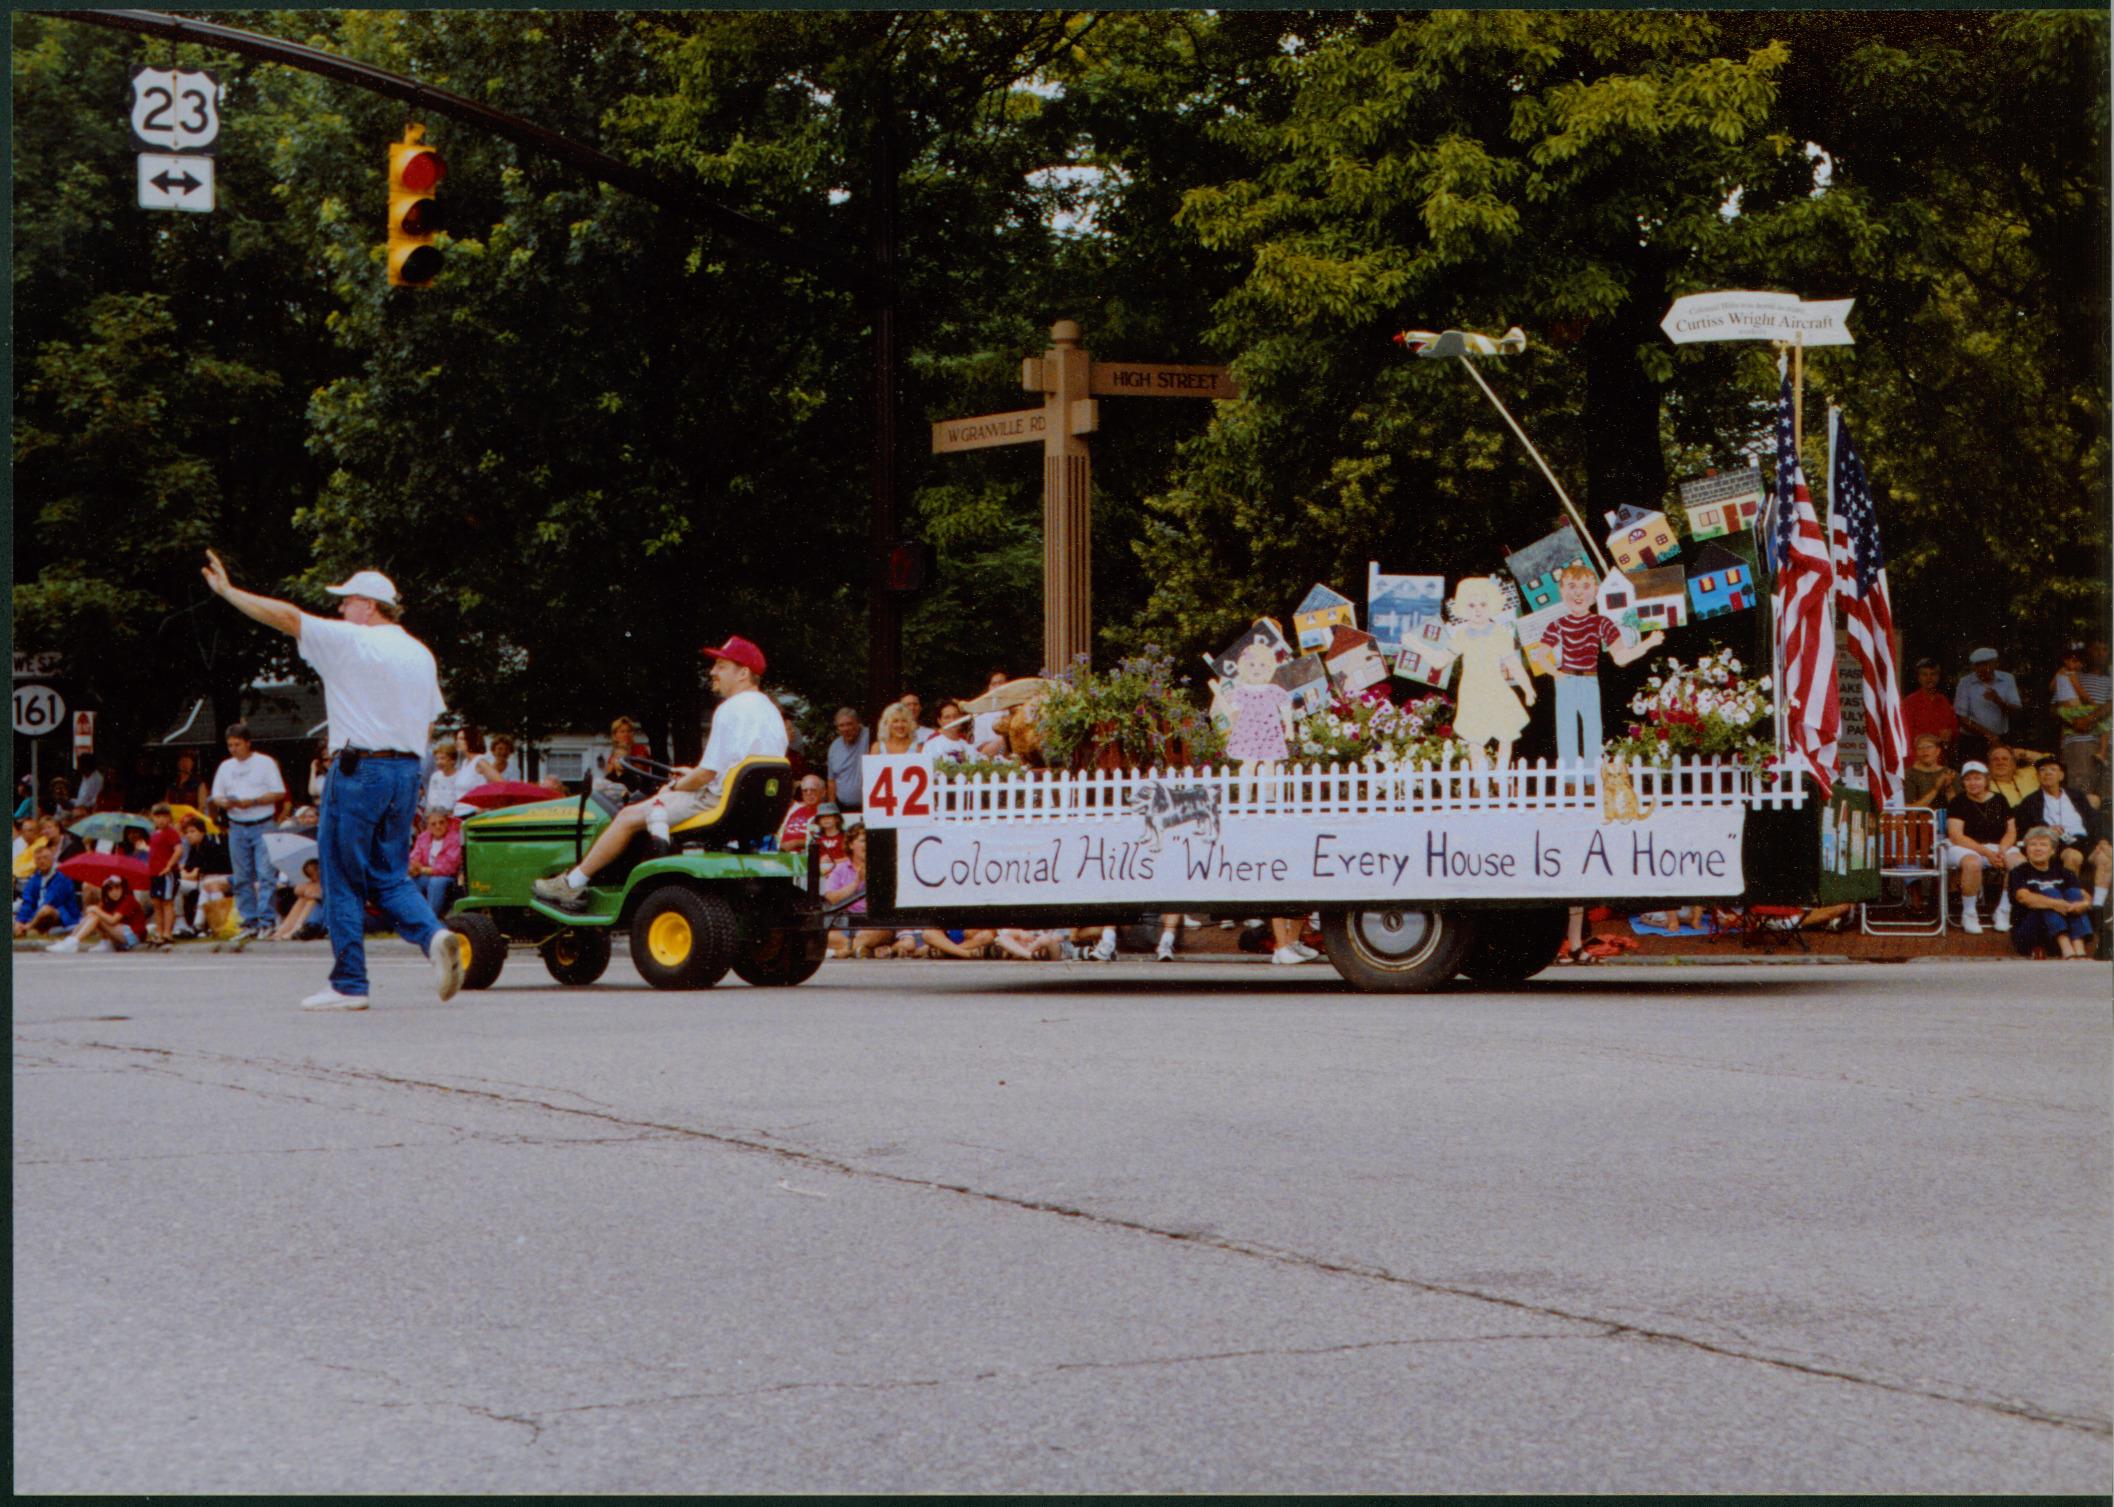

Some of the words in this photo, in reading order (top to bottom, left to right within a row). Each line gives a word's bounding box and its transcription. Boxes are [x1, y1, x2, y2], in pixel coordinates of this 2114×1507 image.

[143, 86, 209, 134] 23
[1675, 314, 1725, 333] Curtiss
[1728, 311, 1776, 329] Wright
[1778, 314, 1833, 330] Aircraft
[1113, 371, 1151, 388] HIGH
[1157, 372, 1218, 390] STREET
[960, 418, 1024, 442] GRANVILLE
[1030, 416, 1046, 432] RD
[14, 694, 55, 726] 161
[868, 765, 930, 816] 42
[912, 835, 1062, 888] Colonial
[1077, 835, 1154, 881] Hills
[1313, 834, 1409, 886] Every
[1426, 830, 1515, 877] House
[1535, 830, 1561, 877] Is
[1582, 829, 1613, 876] A
